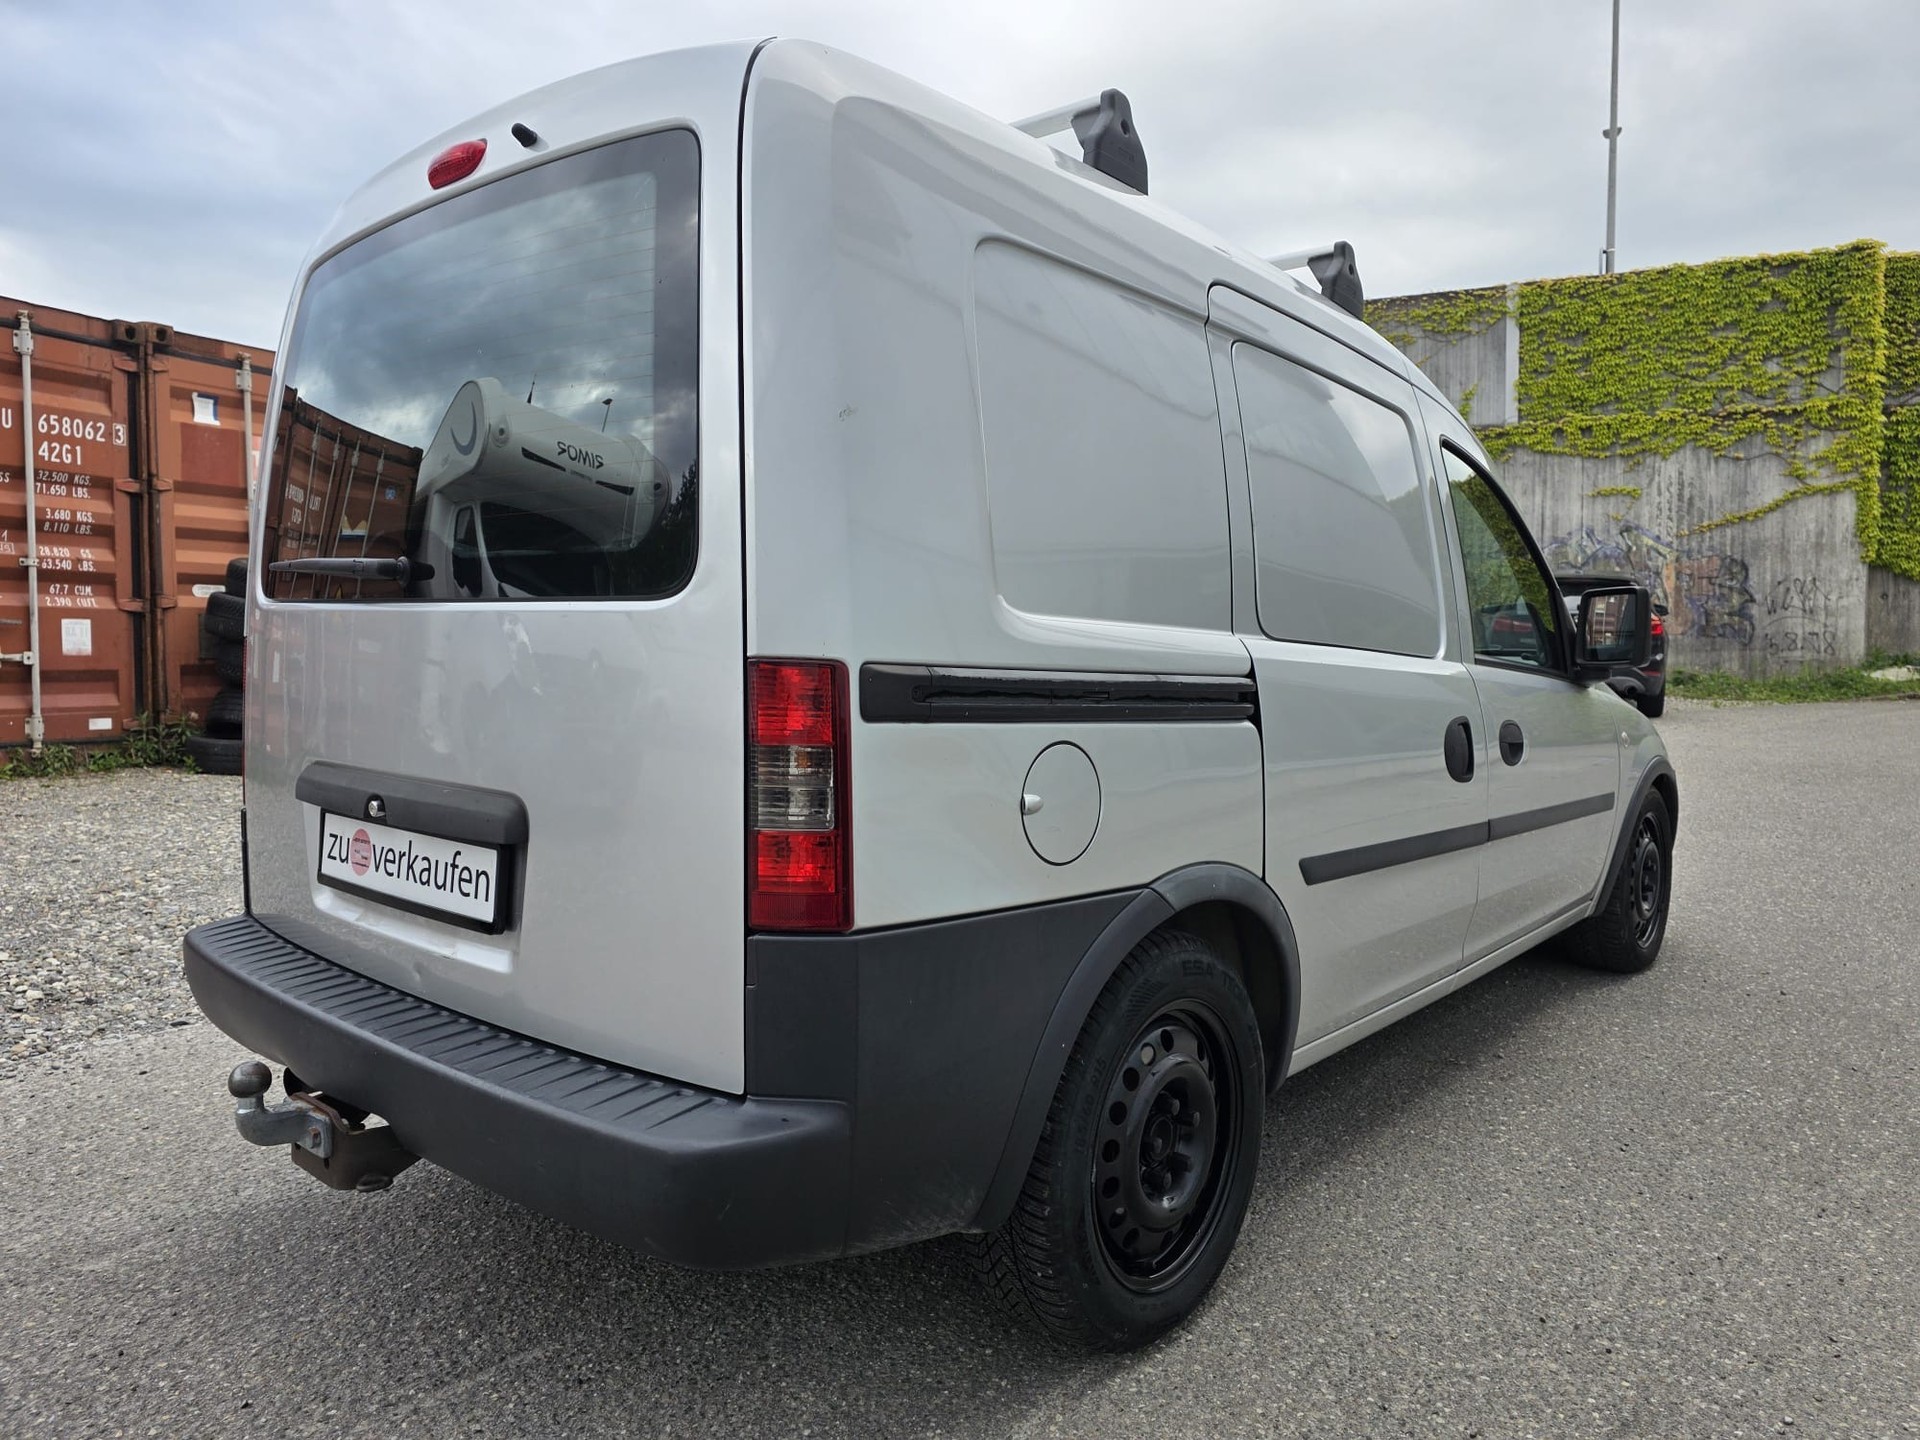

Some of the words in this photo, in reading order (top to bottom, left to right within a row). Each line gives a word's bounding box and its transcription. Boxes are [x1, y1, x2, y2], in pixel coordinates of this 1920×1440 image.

[38, 413, 106, 442] 658062
[115, 424, 125, 444] 3
[38, 440, 82, 465] 42G1
[37, 470, 69, 483] 32.500
[36, 482, 67, 496] 71.650
[72, 486, 92, 499] LBS.
[45, 508, 71, 521] 3.680
[76, 511, 95, 523] KGS.
[75, 523, 93, 535] LBS.
[42, 559, 72, 570] 63.540
[49, 584, 69, 595] 67.7
[45, 597, 72, 607] 2.390
[327, 833, 350, 864] zu
[372, 840, 490, 902] verkaufen
